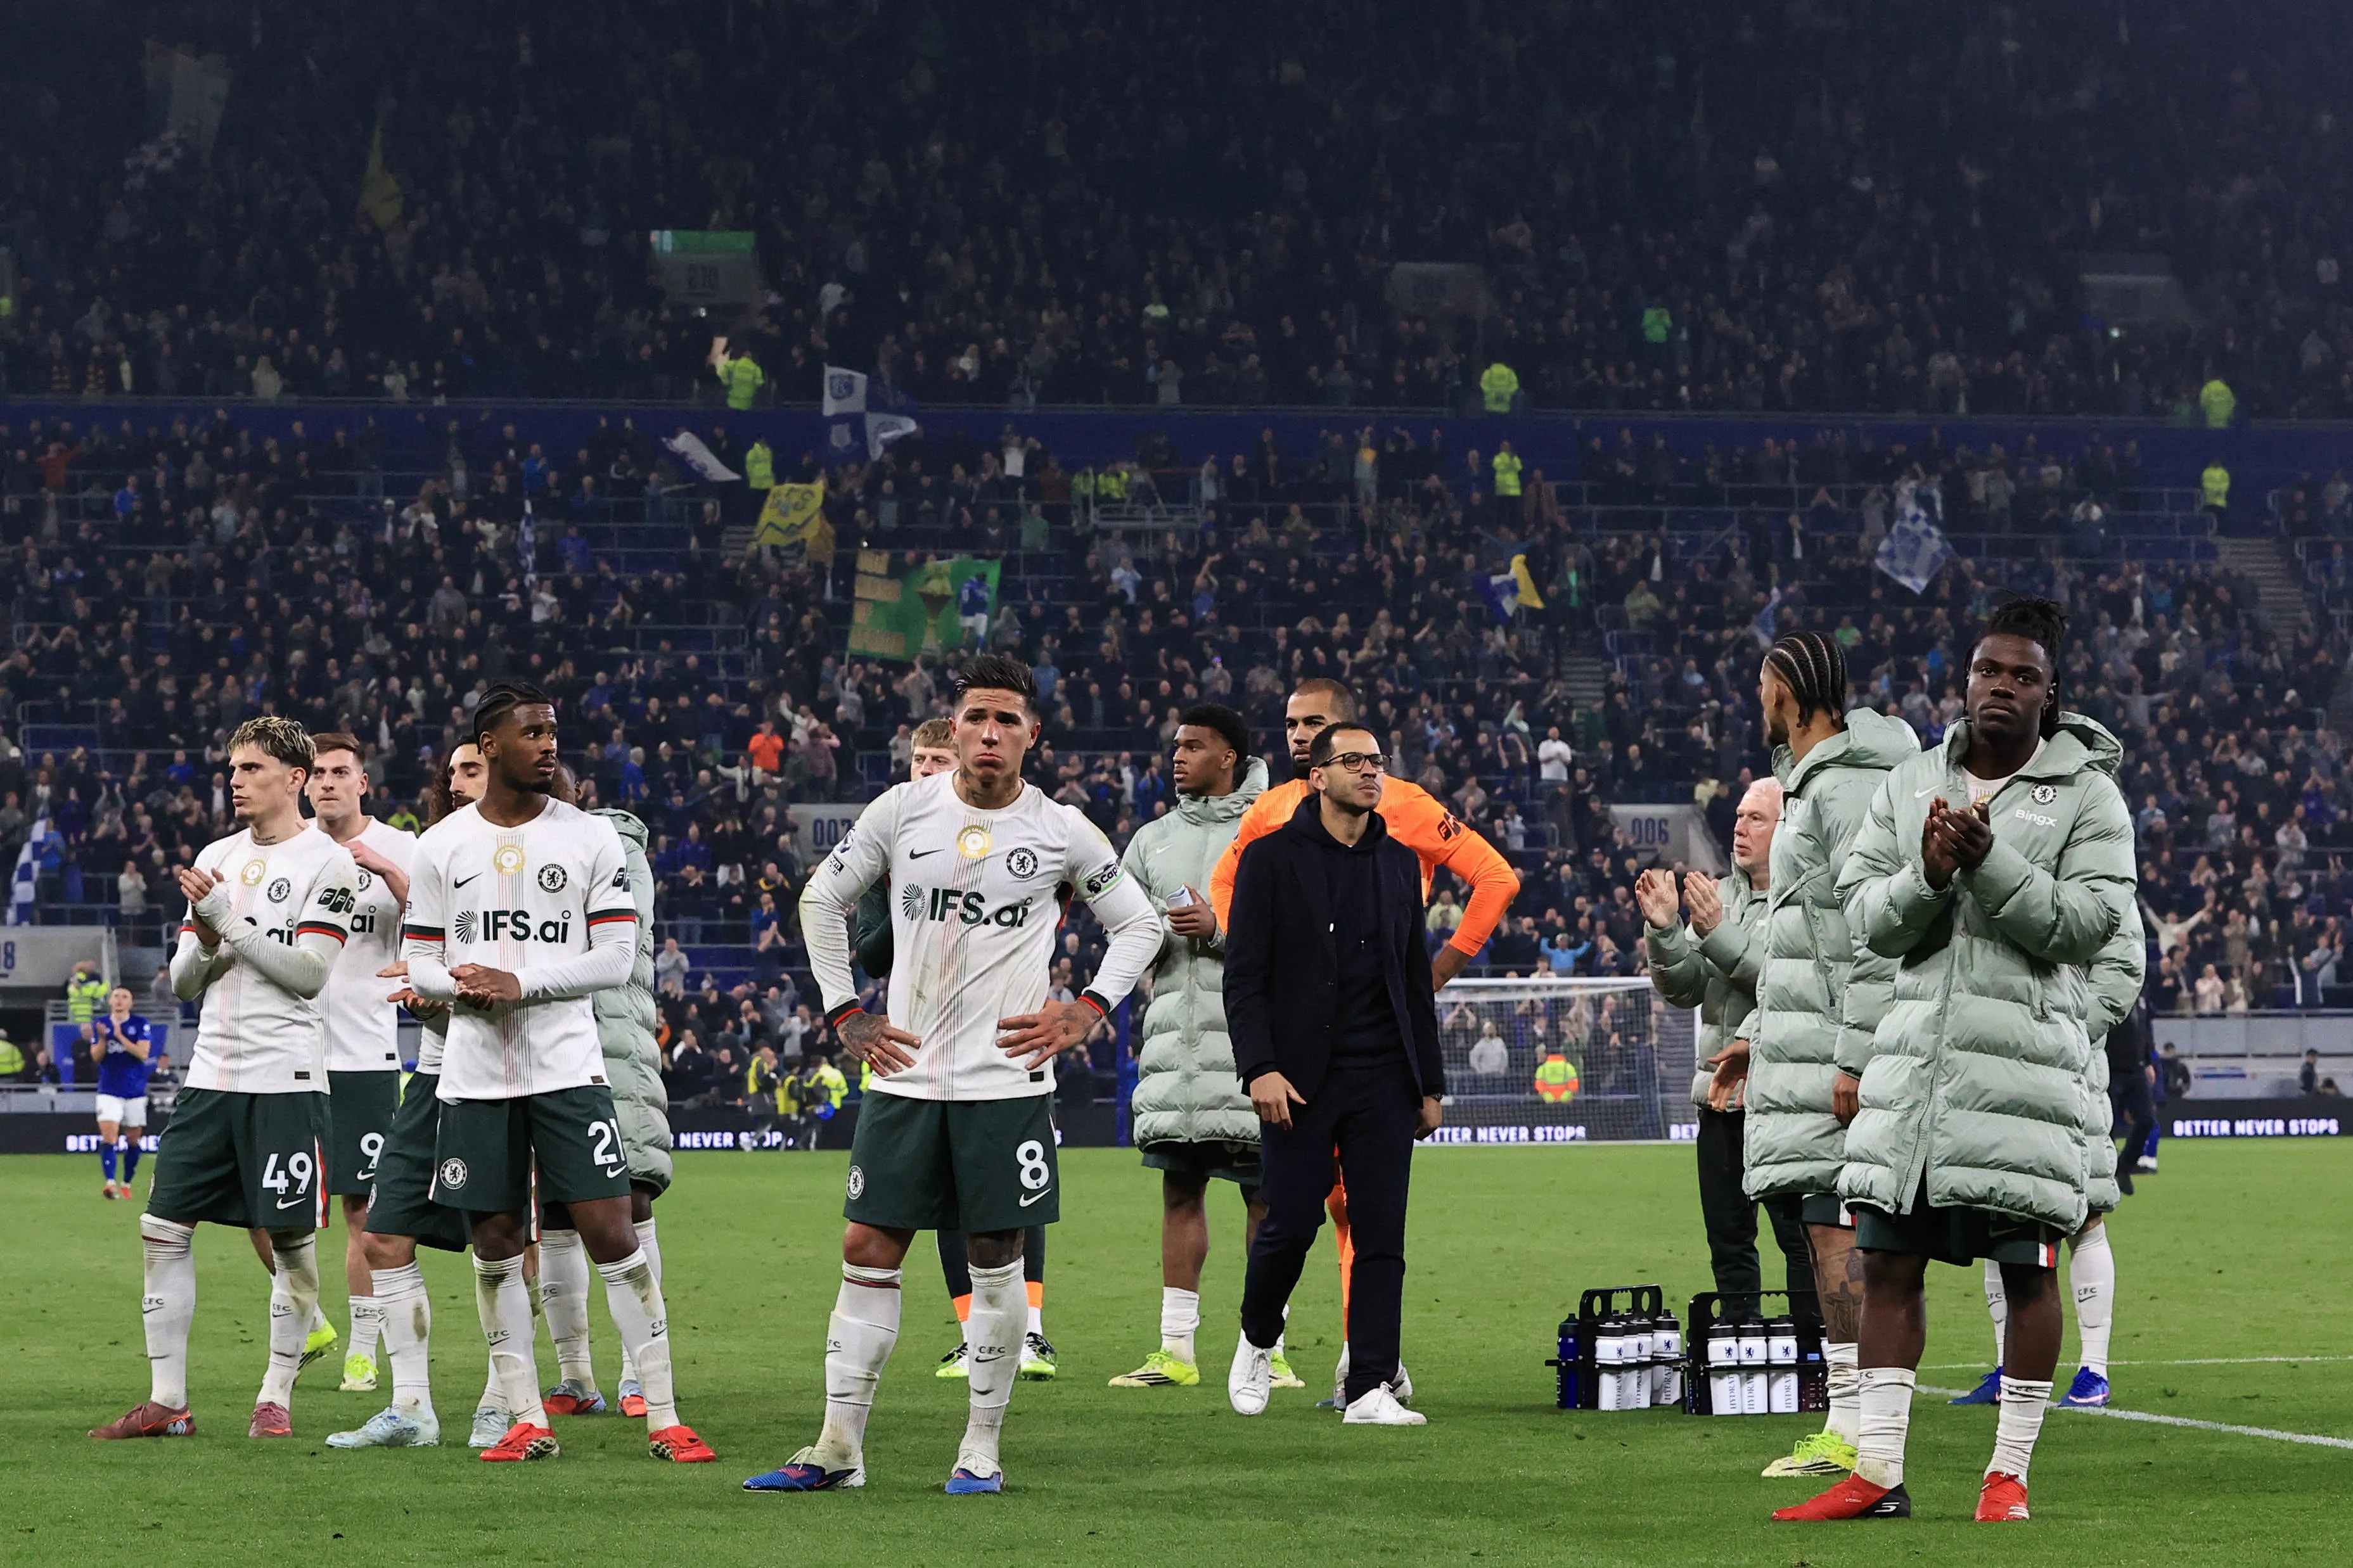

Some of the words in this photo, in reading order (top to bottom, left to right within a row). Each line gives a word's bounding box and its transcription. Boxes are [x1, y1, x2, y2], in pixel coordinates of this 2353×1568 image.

[1631, 817, 1669, 845] 006
[1100, 865, 1119, 883] Cap
[319, 890, 355, 911] FPT
[930, 887, 1033, 927] IFS.ai
[484, 910, 571, 943] IFS.ai
[0, 941, 15, 969] 8
[679, 1132, 734, 1148] NEVER
[1422, 1127, 1471, 1143] TTER
[1477, 1126, 1528, 1142] NEVER
[1534, 1126, 1585, 1141] STOPS
[2173, 1120, 2230, 1136] BETTER
[2234, 1119, 2285, 1135] NEVER
[2289, 1119, 2339, 1135] STOPS
[360, 1132, 385, 1169] 9
[588, 1118, 625, 1166] 21
[262, 1152, 312, 1194] 49
[1016, 1140, 1049, 1190] 8
[488, 1330, 510, 1338] CFC
